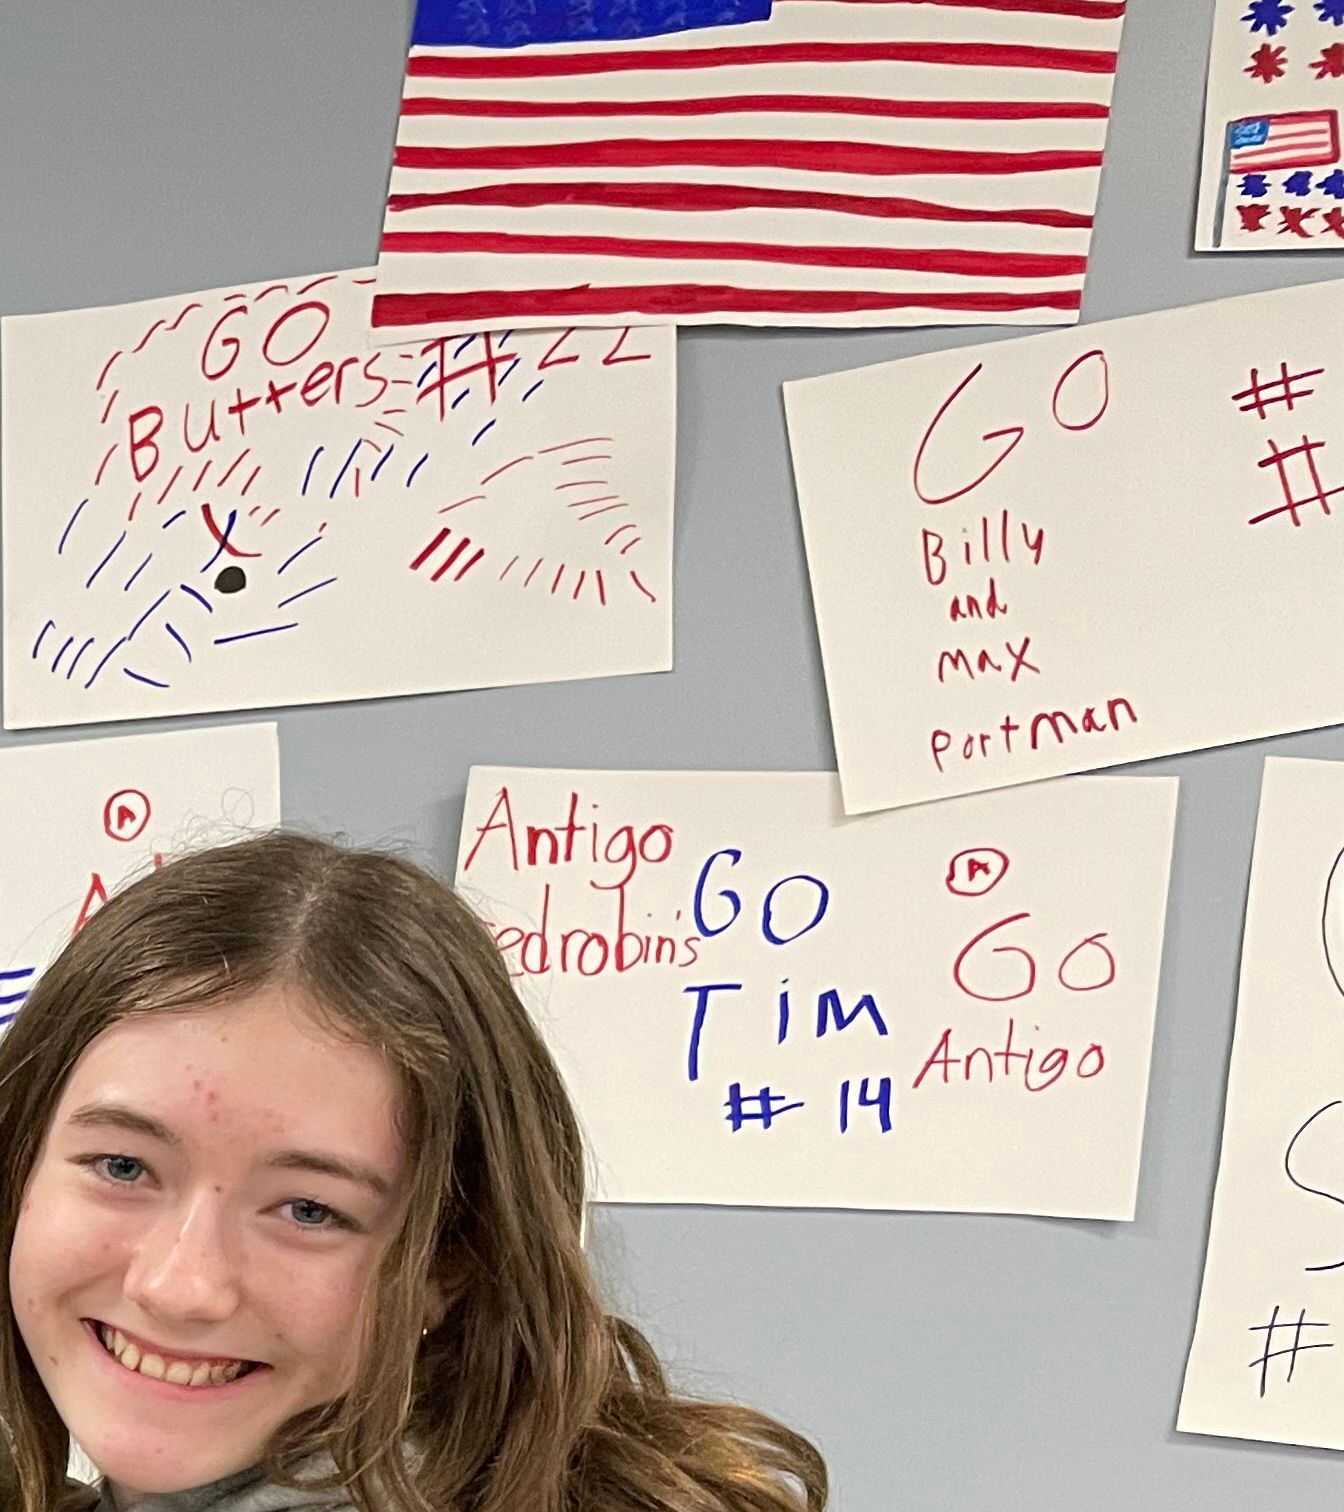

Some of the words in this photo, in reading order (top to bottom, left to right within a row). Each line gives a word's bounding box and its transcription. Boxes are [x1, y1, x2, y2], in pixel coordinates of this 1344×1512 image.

[201, 300, 331, 381] GO
[922, 509, 1045, 587] Billy
[949, 578, 1009, 622] and
[464, 787, 674, 890] Antigo
[912, 1018, 1106, 1092] Antigo
